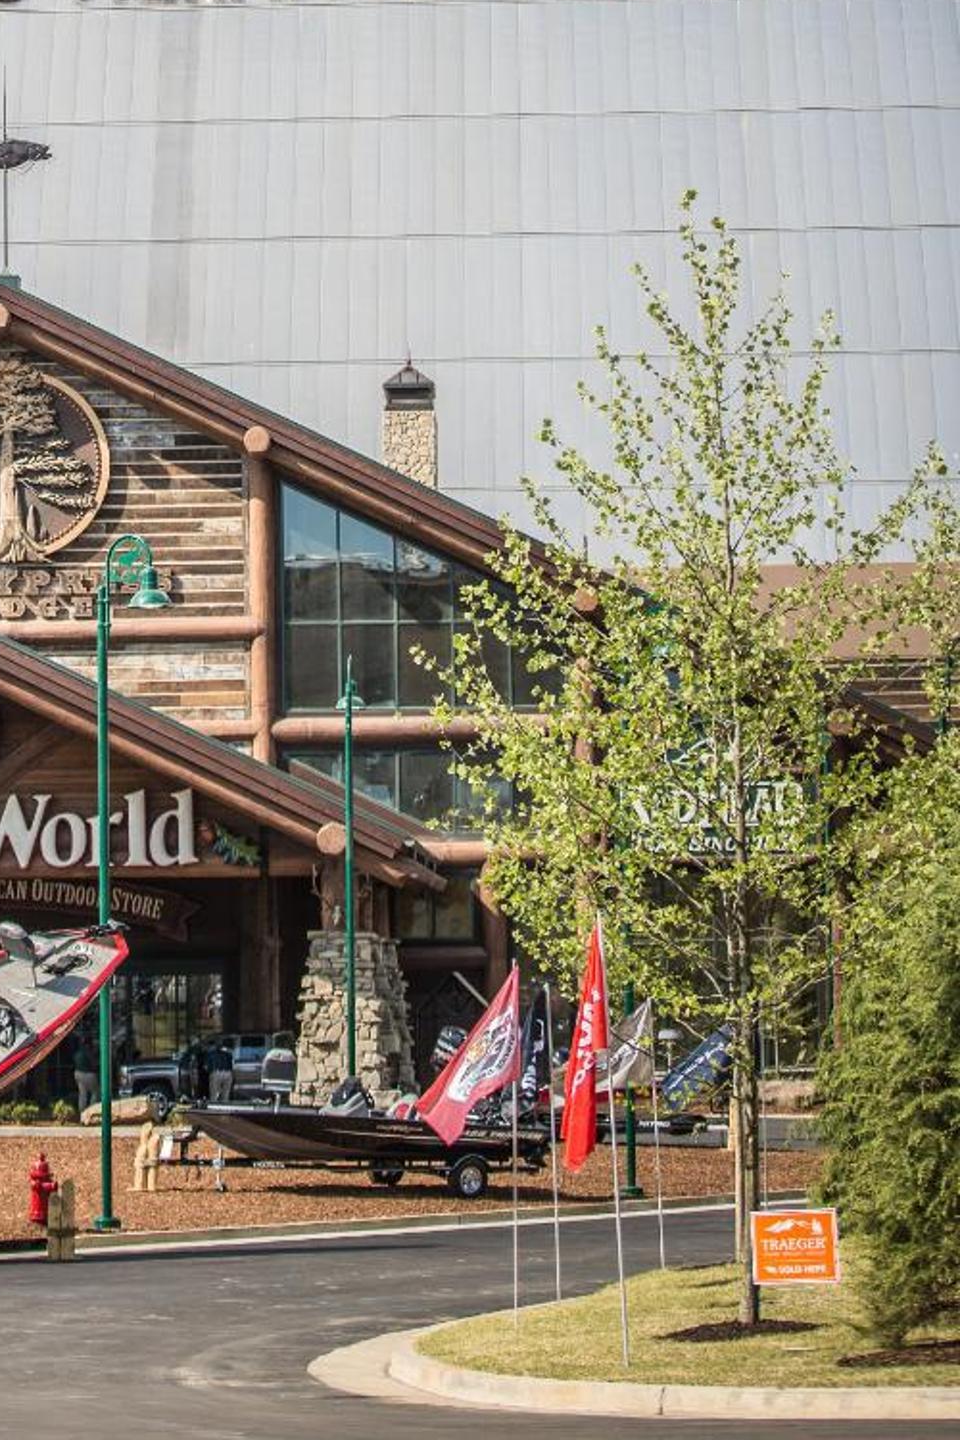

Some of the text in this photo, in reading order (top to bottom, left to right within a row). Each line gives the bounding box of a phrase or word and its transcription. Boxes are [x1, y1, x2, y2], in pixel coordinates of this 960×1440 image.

[31, 878, 99, 908] OUTDOO
[111, 886, 165, 920] STORE
[761, 1237, 826, 1251] TRAEGER
